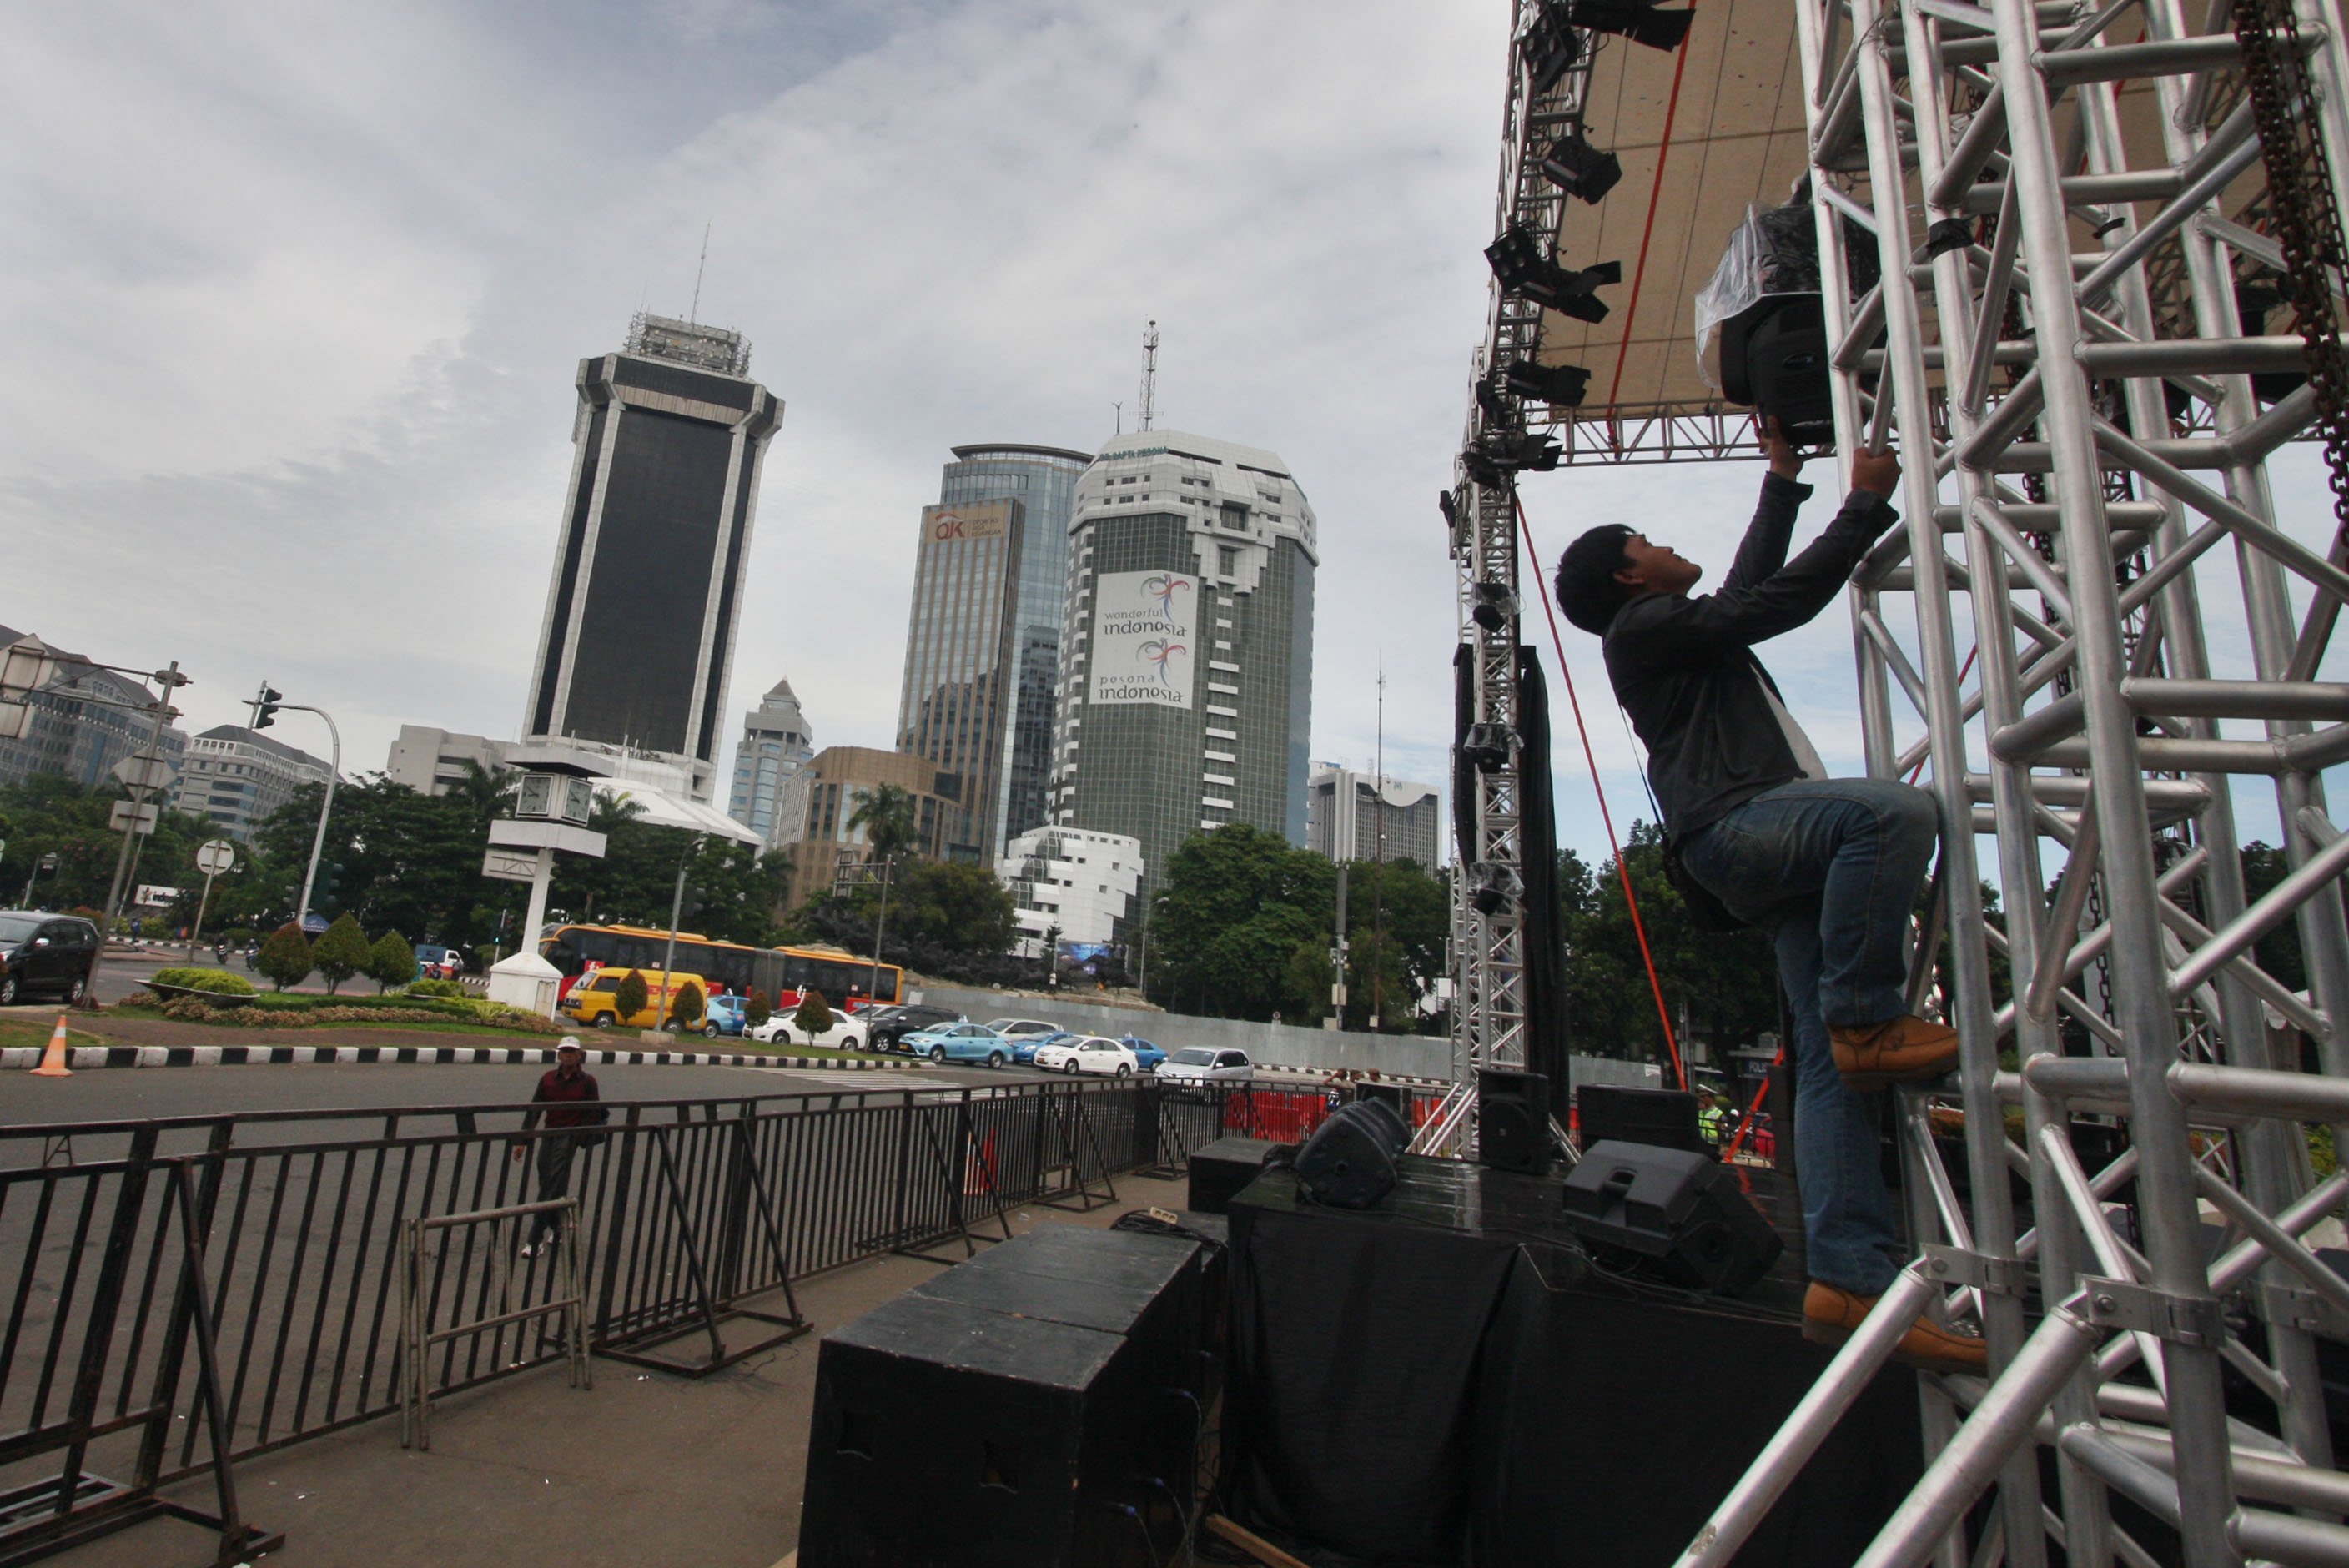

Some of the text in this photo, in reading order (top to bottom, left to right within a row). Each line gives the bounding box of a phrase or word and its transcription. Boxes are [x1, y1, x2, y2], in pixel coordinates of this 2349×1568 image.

[1104, 608, 1164, 620] wonderful
[1104, 620, 1188, 637] indonesia
[1100, 674, 1155, 686] pesona
[1099, 685, 1185, 703] indonesia
